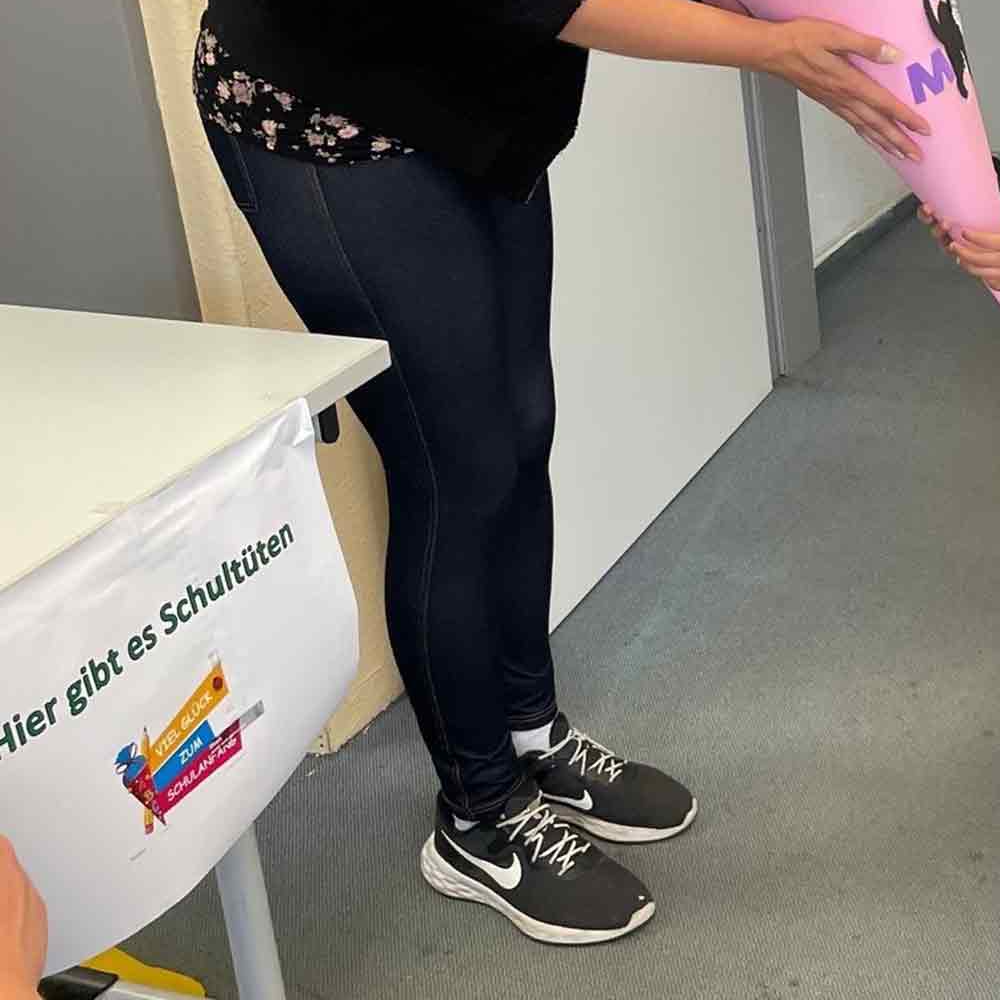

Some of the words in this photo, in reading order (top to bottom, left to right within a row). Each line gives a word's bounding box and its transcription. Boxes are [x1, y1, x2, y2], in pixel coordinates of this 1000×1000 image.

[66, 648, 123, 716] gibt
[128, 624, 158, 661] es
[160, 522, 295, 635] Schultüten
[154, 730, 179, 757] VIEL
[179, 736, 204, 766] ZUM
[167, 738, 238, 802] SCHULANFANG
